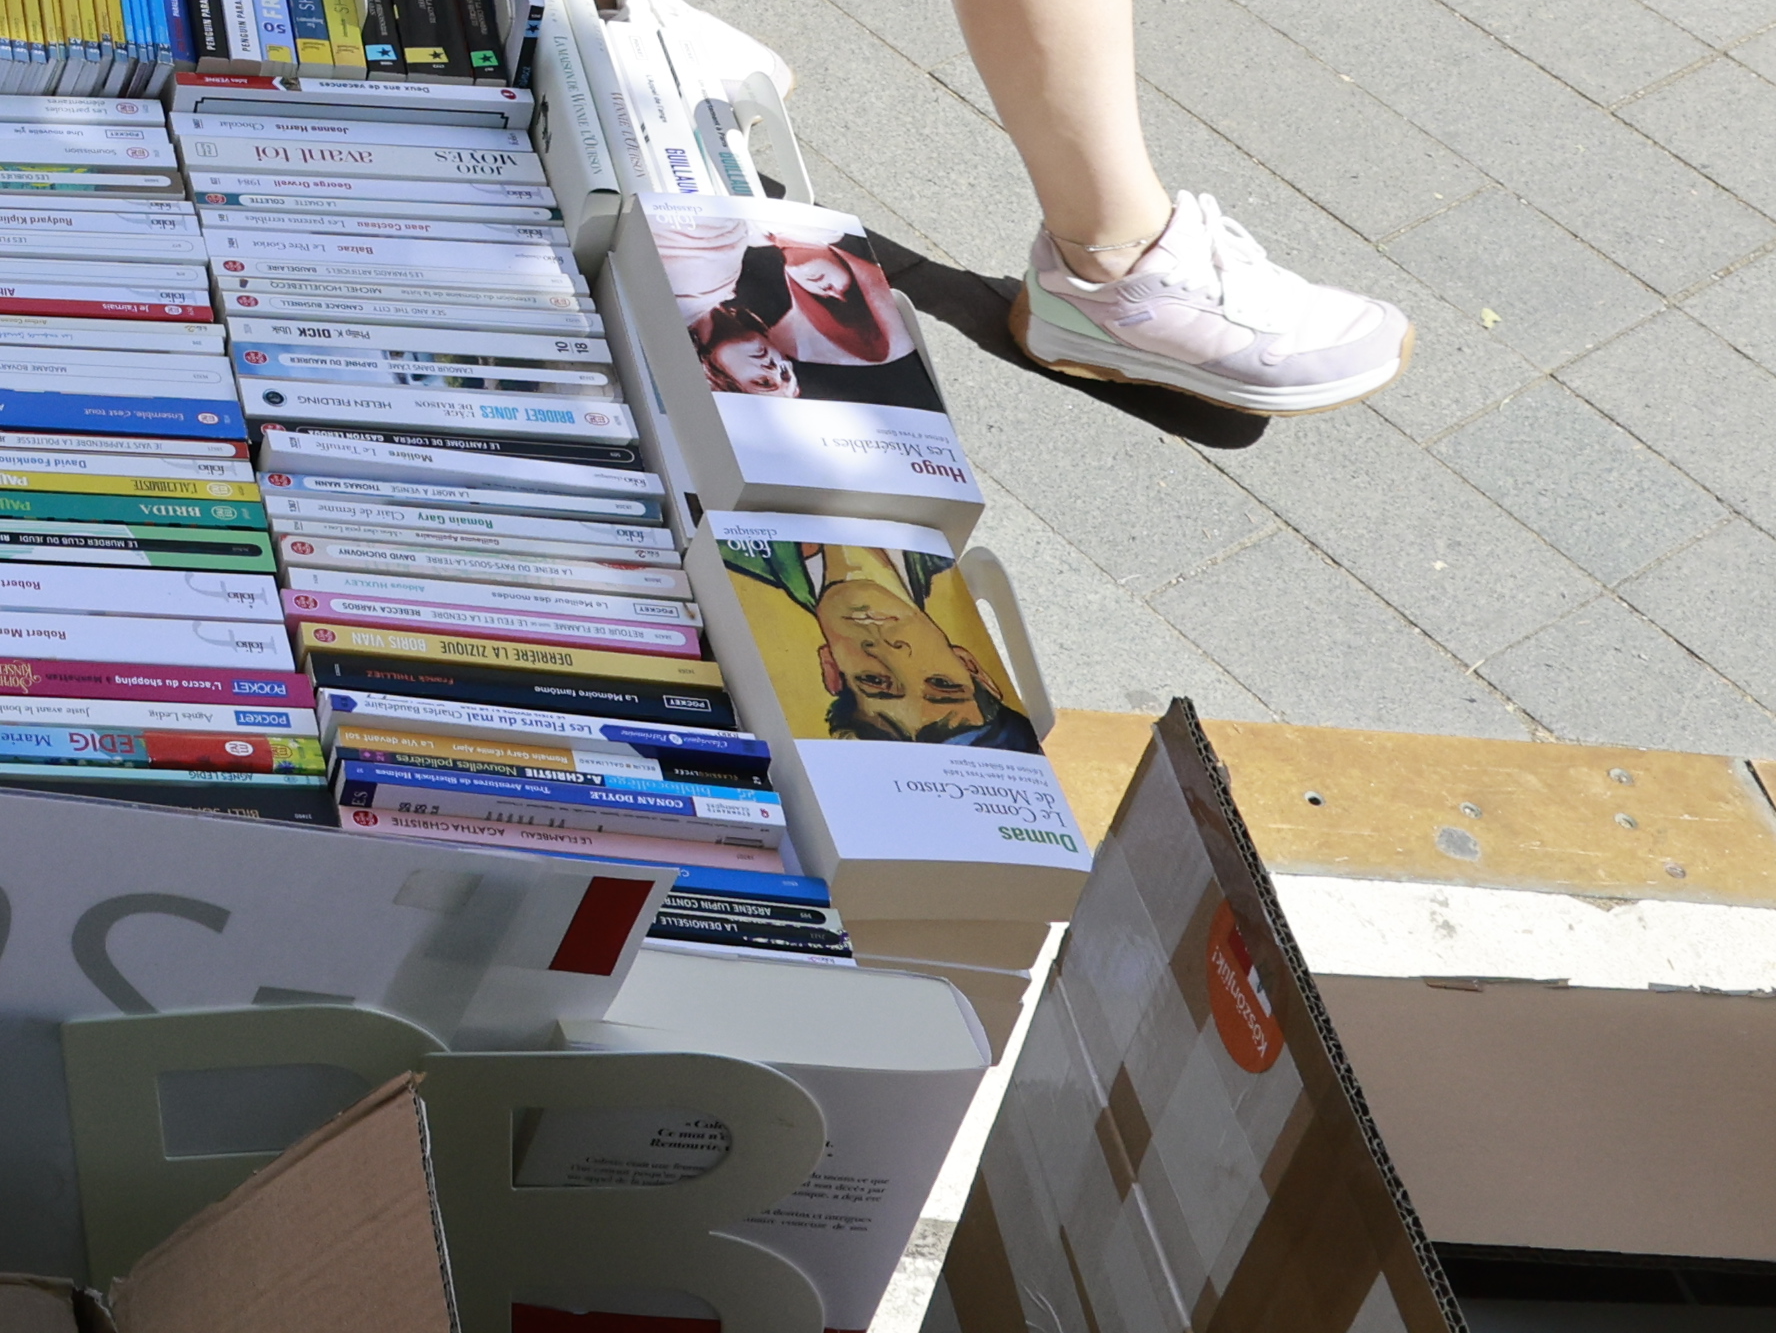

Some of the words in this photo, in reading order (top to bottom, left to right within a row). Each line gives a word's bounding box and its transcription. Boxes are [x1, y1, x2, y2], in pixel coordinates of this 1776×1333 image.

[254, 145, 291, 162] toi
[296, 145, 373, 164] avant
[910, 459, 967, 484] Hugo
[139, 503, 202, 518] BRIDA
[438, 640, 488, 661] ZIZIQUE
[491, 645, 509, 663] LA
[513, 647, 574, 668] DERRIÈRE
[997, 824, 1078, 854] Dumas
[1211, 945, 1268, 1058] Köszönjük!
